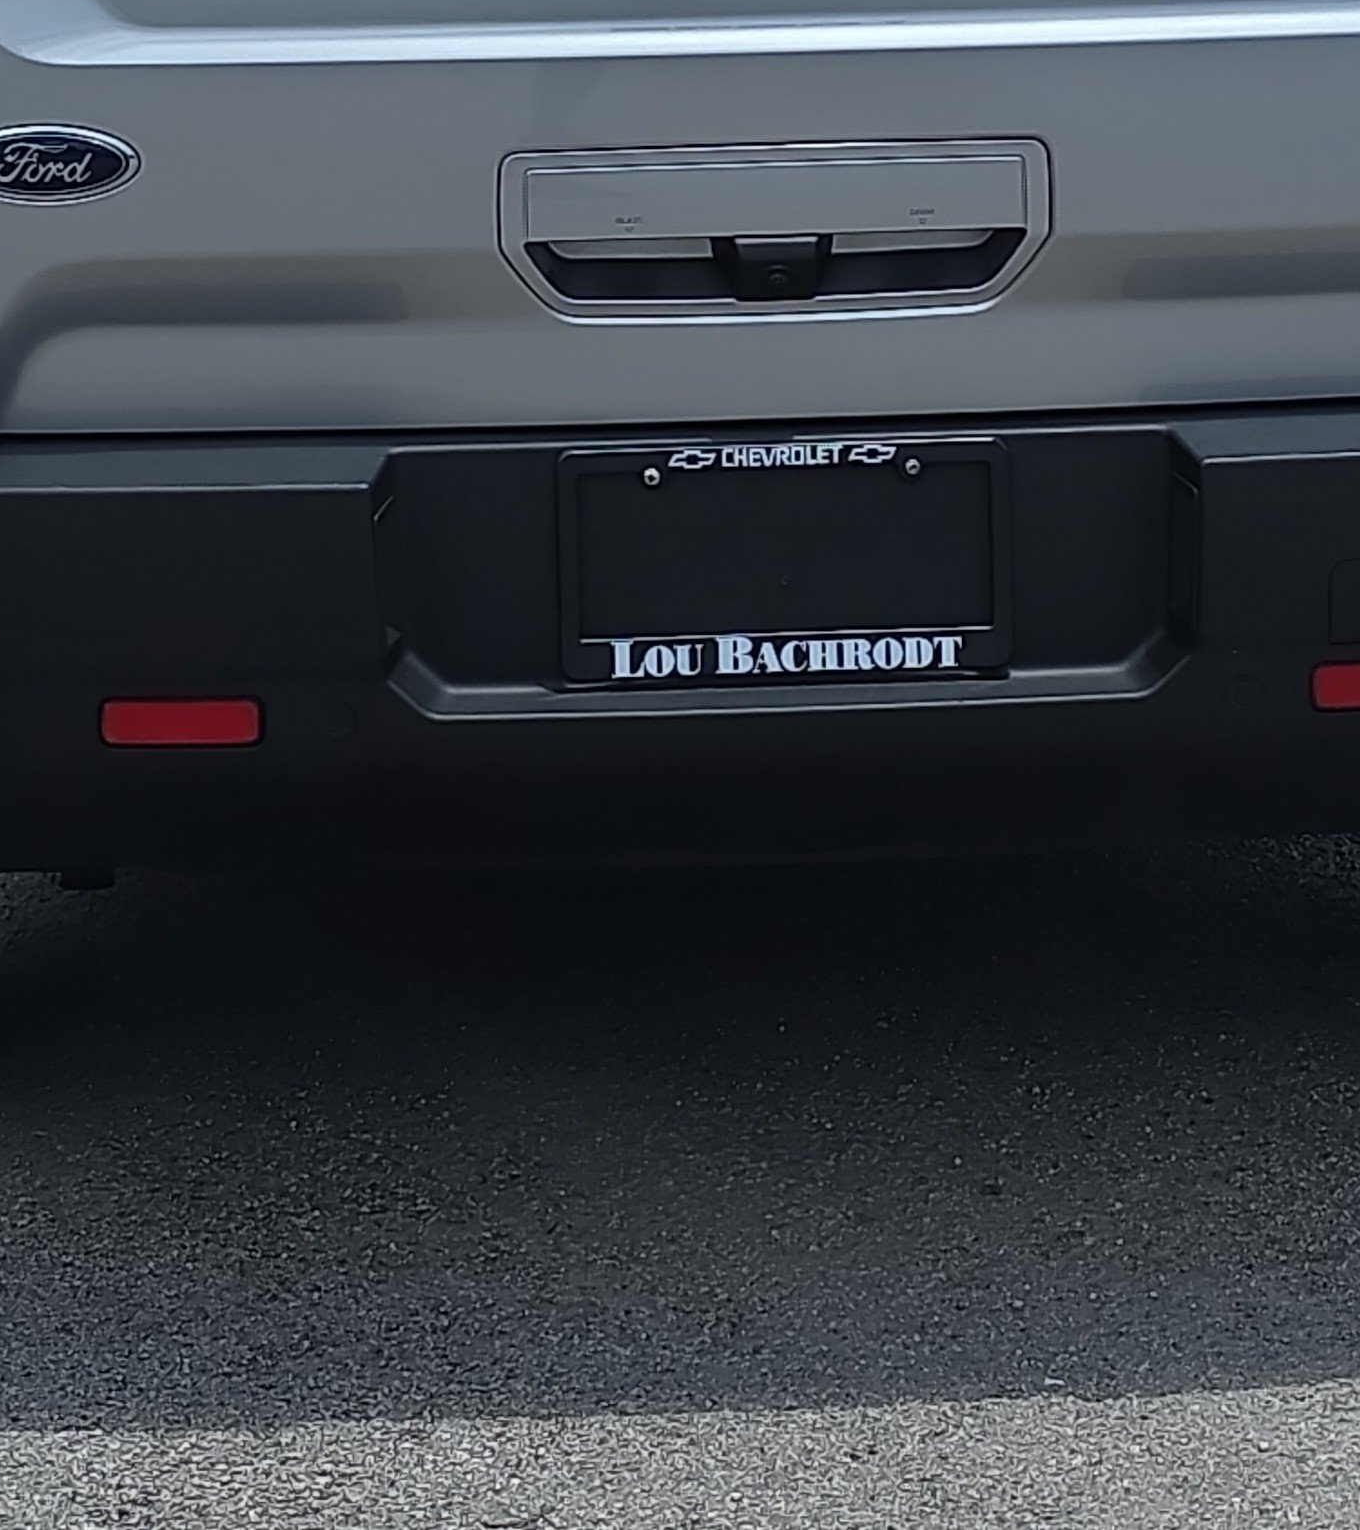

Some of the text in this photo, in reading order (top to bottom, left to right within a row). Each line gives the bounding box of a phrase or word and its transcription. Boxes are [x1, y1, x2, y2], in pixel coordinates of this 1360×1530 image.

[721, 443, 844, 468] CHEVROLET
[610, 634, 963, 679] LOU BACHRODT
